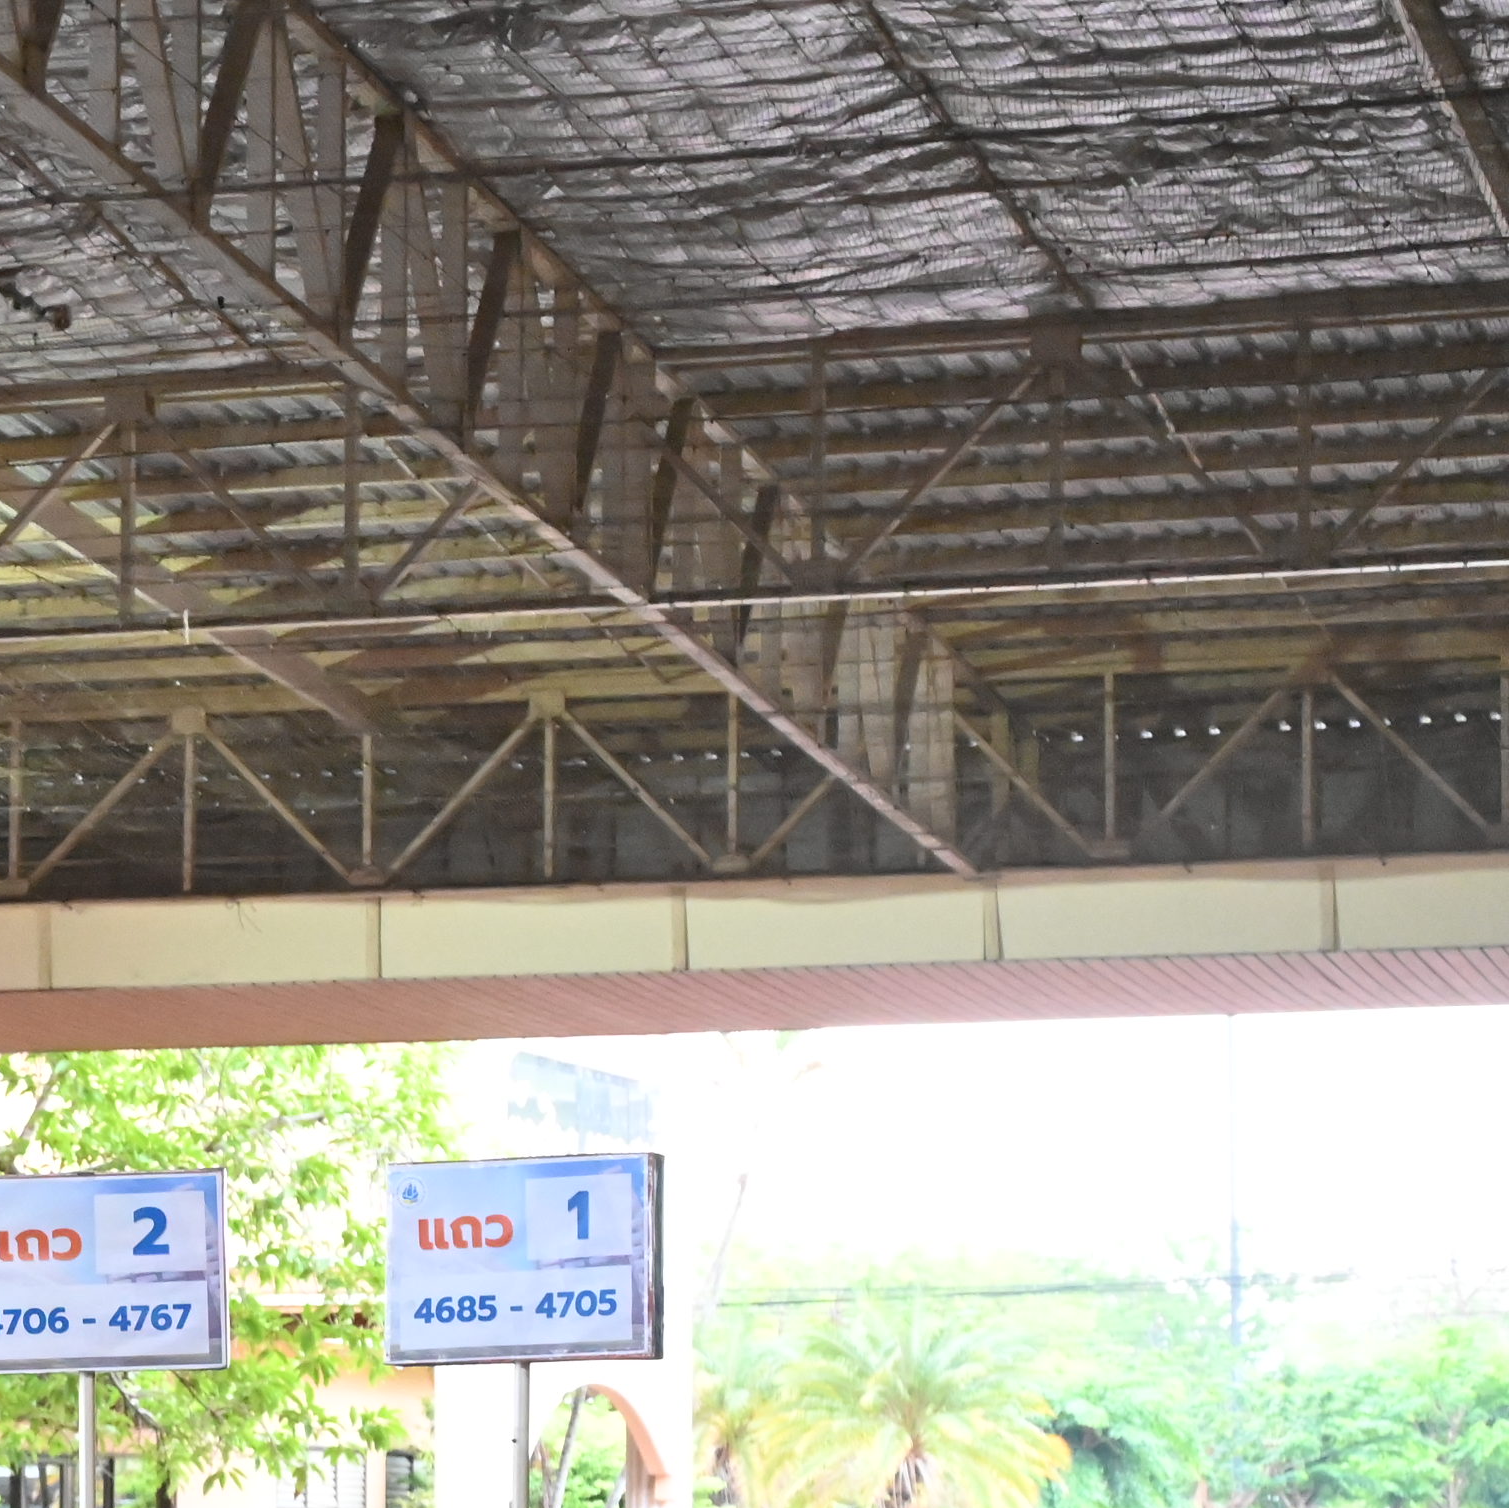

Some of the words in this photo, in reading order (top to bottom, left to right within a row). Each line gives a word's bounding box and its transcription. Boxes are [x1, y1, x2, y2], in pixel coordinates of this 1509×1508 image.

[132, 1205, 172, 1257] 2
[418, 1214, 514, 1251] แถว
[566, 1190, 592, 1241] 1
[107, 1303, 193, 1332] 4767
[413, 1294, 499, 1325] 4685
[533, 1287, 619, 1321] 4705
